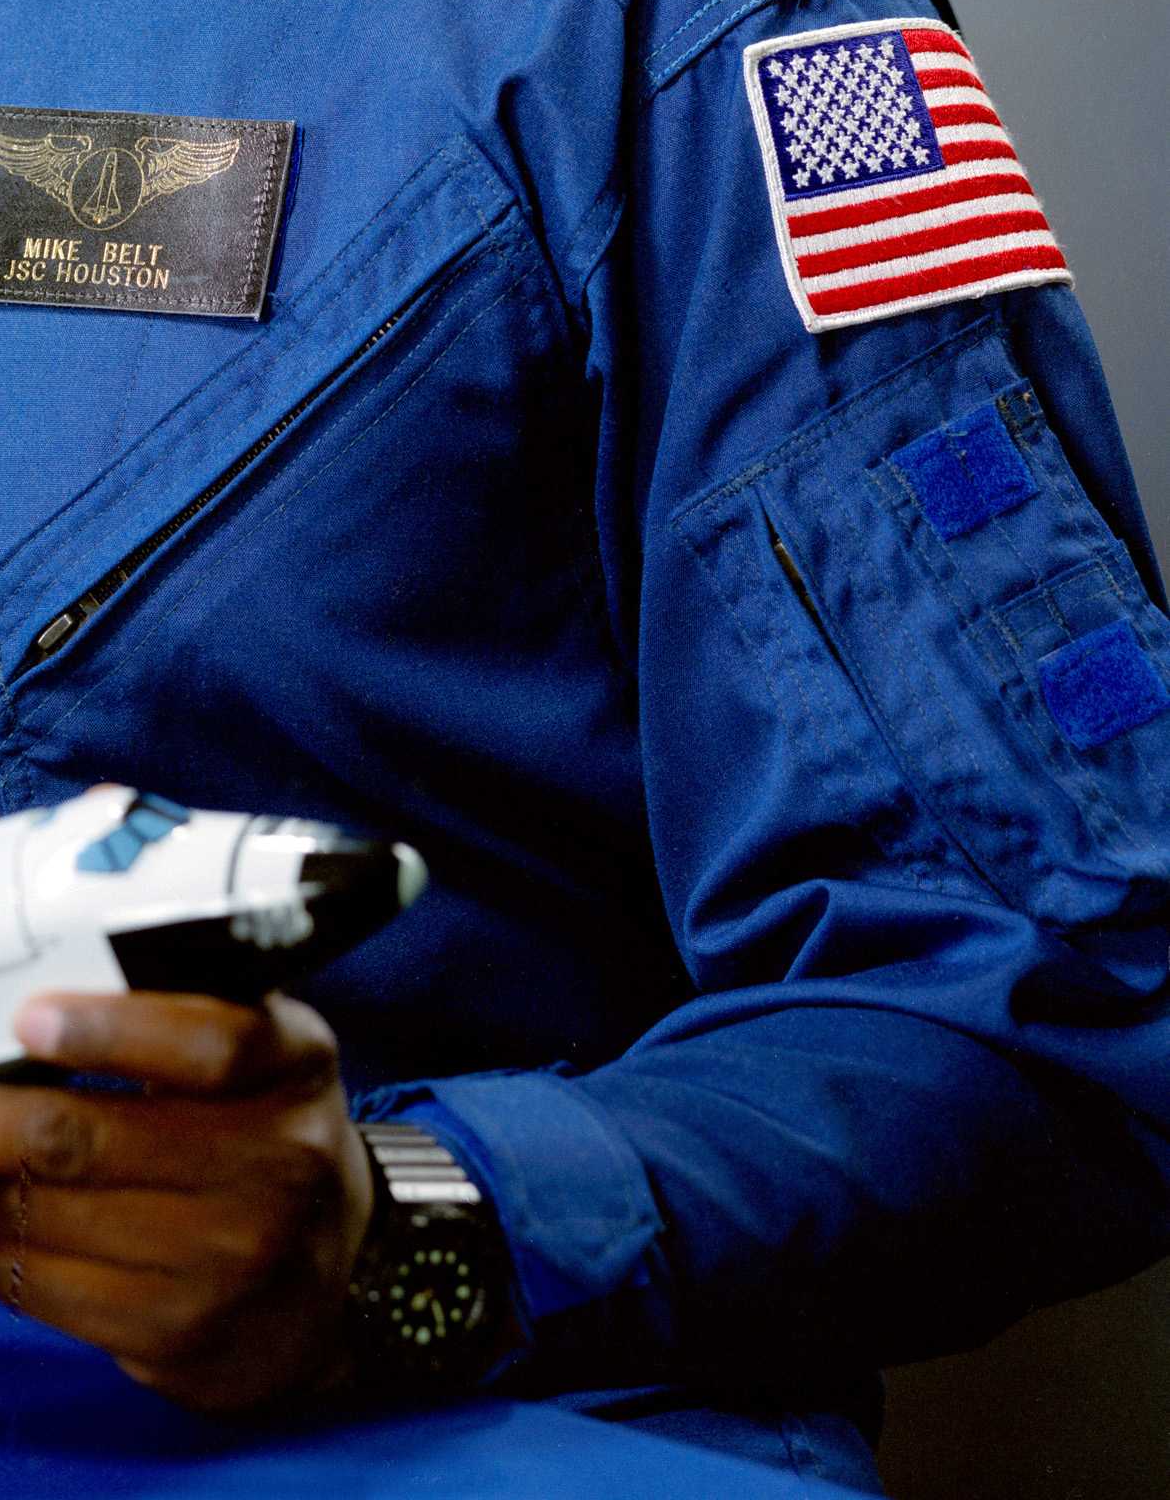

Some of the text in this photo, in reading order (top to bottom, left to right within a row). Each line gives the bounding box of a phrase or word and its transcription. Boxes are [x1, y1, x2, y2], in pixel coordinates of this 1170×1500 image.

[23, 237, 163, 266] MIKE BELT
[4, 259, 171, 289] JSC HOUSTON
